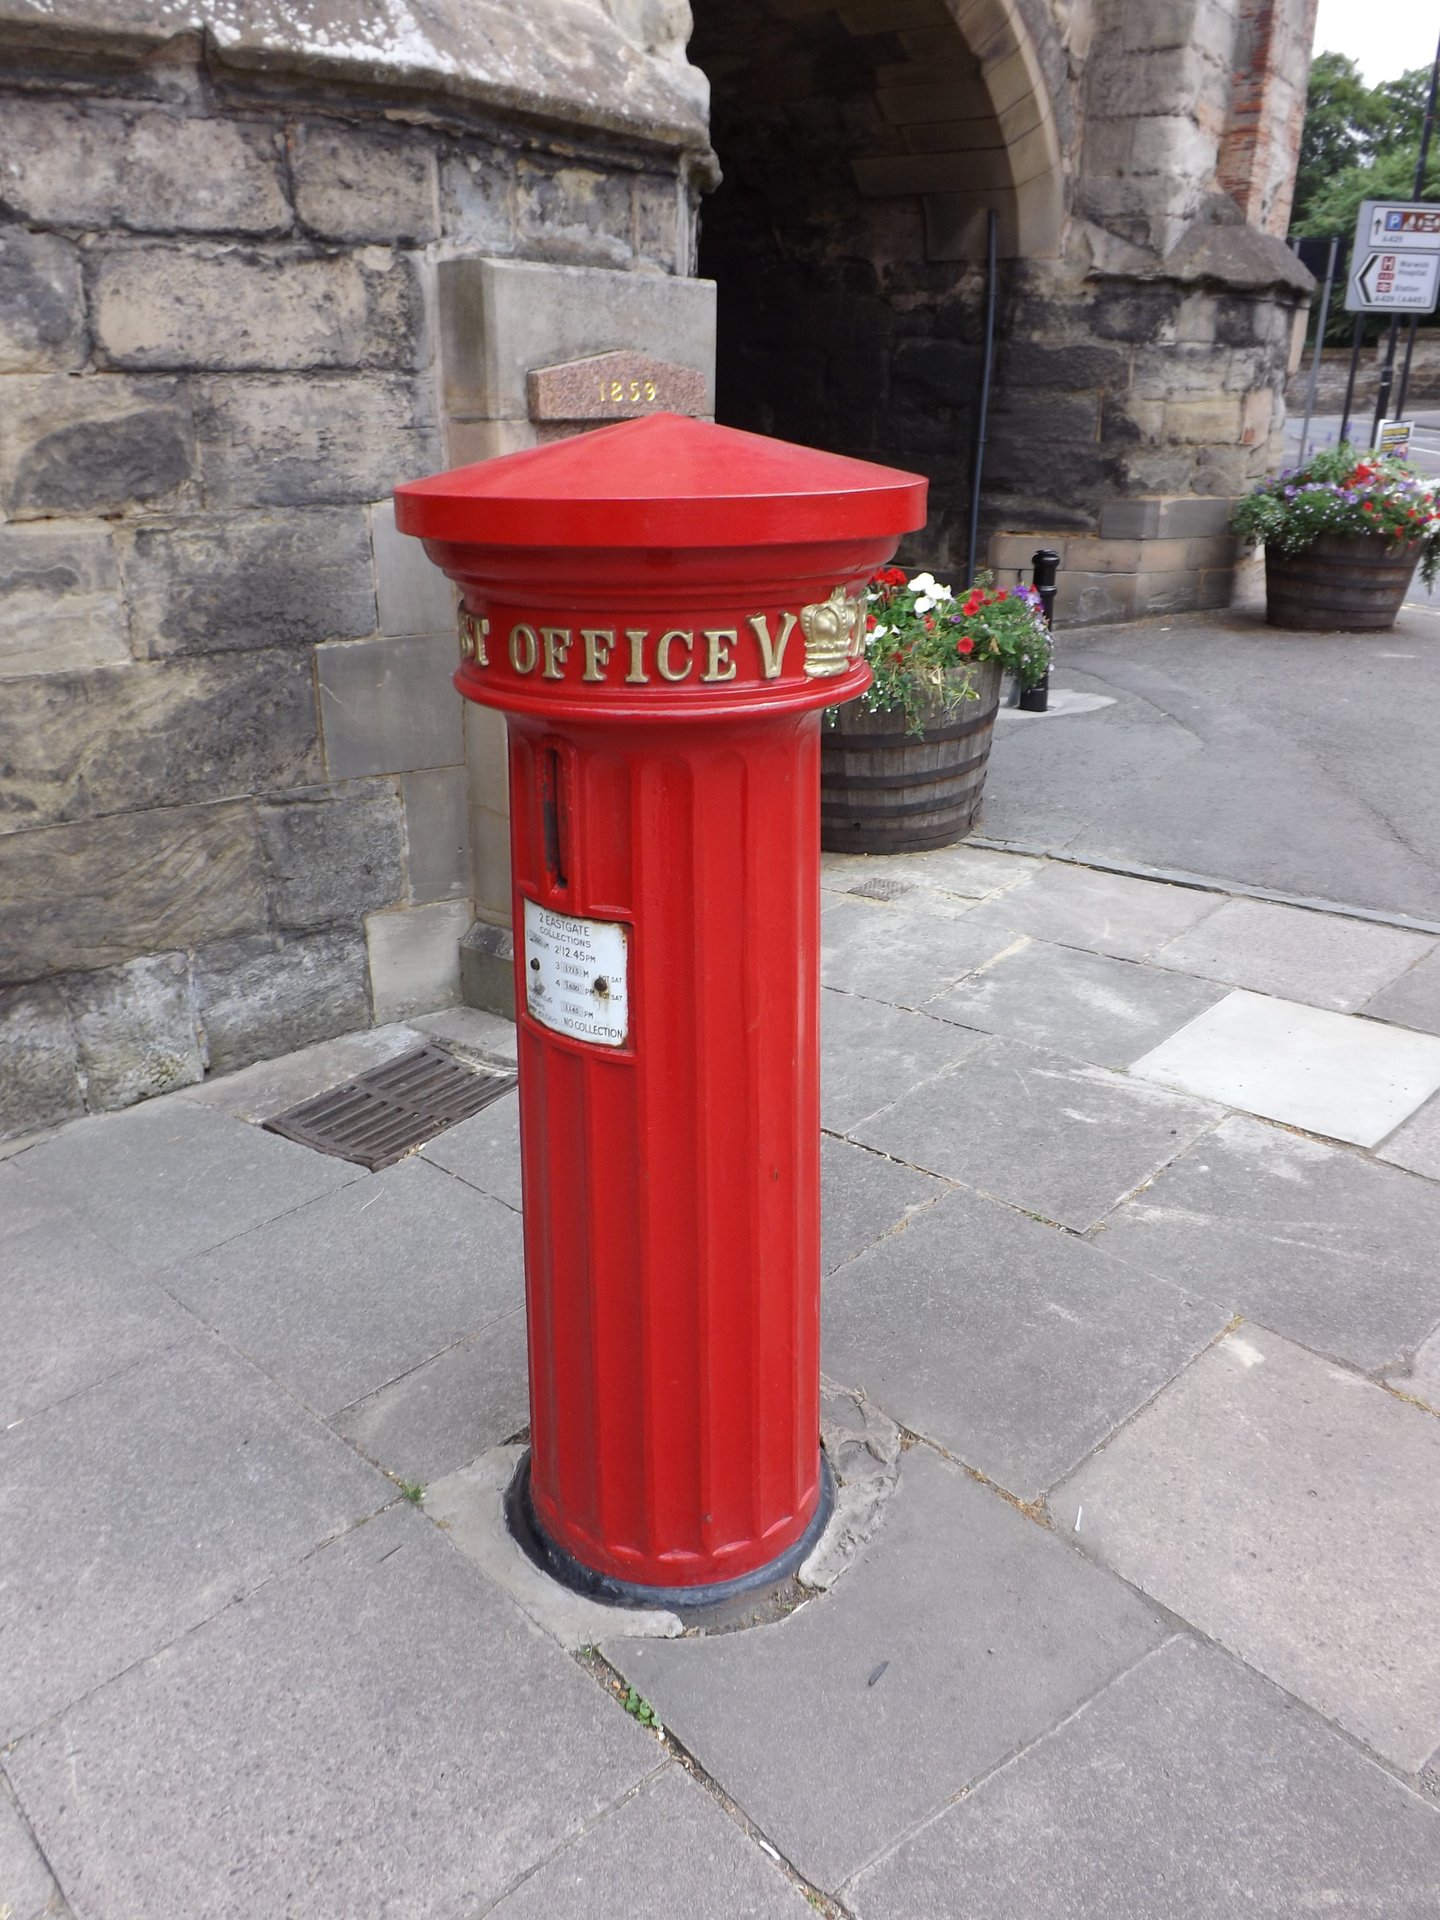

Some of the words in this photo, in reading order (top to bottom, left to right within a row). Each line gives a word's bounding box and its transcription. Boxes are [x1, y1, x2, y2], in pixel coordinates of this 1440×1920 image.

[600, 379, 656, 402] 1859
[508, 624, 738, 683] OFFICE
[539, 913, 543, 923] 2
[546, 915, 590, 937] EASTGATE
[539, 926, 591, 948] COLLECTIONS
[612, 976, 622, 984] SAT
[564, 1017, 573, 1028] NO
[575, 1021, 623, 1038] COLLECTION
